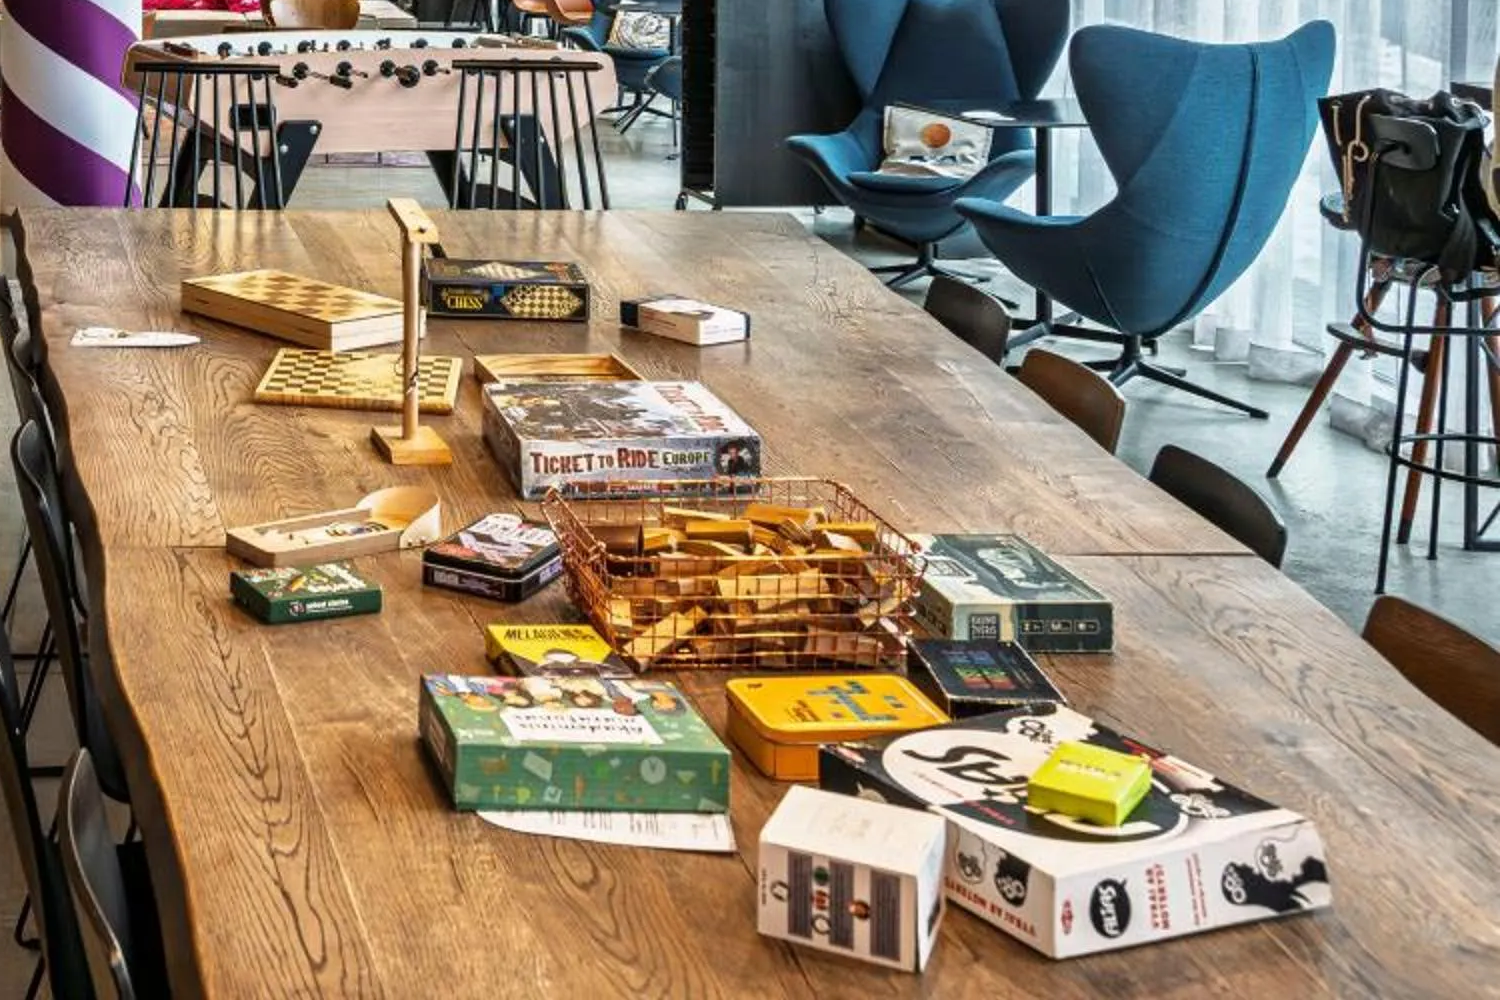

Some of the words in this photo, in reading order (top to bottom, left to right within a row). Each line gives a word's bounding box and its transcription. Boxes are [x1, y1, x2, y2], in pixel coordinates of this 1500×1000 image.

[447, 297, 482, 309] CHESS
[530, 451, 595, 474] TICKET
[597, 455, 614, 469] TO
[617, 447, 660, 469] RIDE
[662, 450, 709, 466] EUROPE
